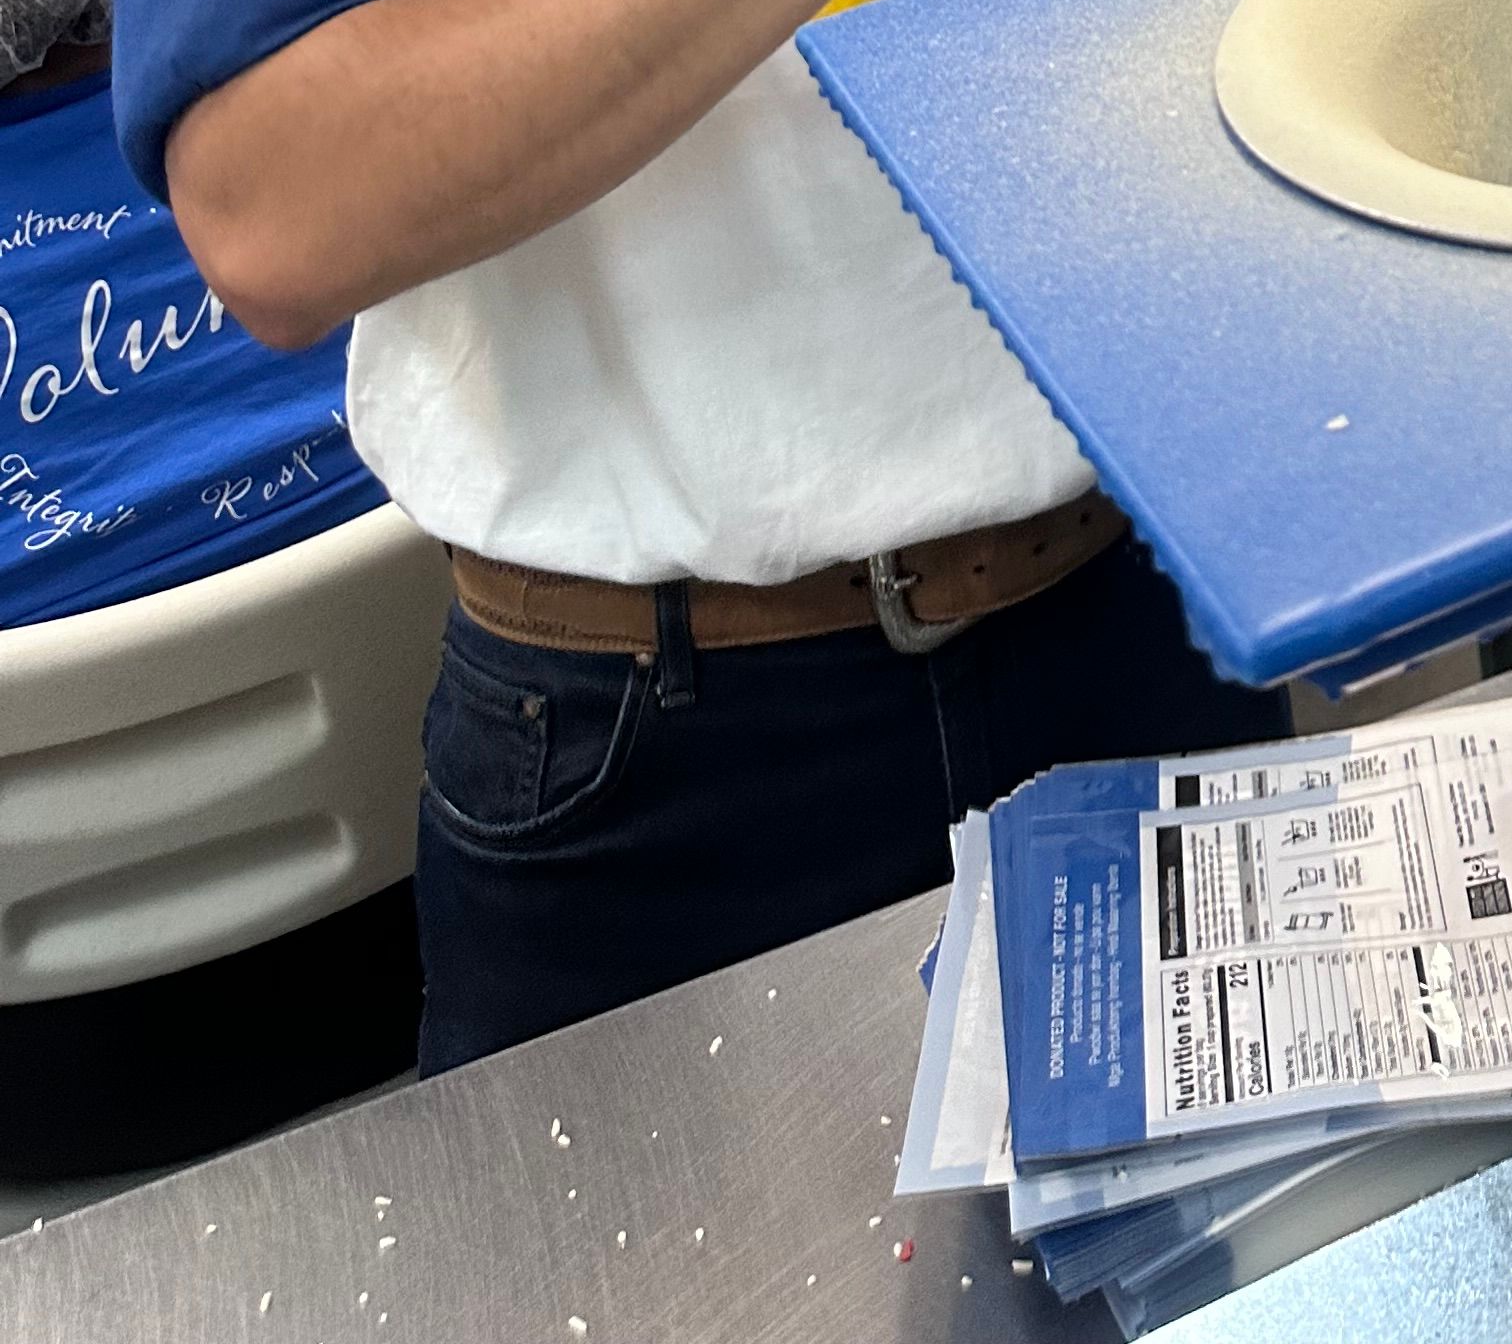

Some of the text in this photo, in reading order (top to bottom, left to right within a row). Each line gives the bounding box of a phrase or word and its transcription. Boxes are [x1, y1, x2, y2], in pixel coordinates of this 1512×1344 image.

[0, 204, 132, 258] itment
[0, 453, 144, 551] Integrit
[1053, 875, 1069, 904] SALE
[1052, 932, 1067, 956] NOT
[1053, 905, 1068, 931] FOR
[1051, 963, 1066, 1016] PRODUCT
[1171, 969, 1191, 1019] Facts
[1050, 1016, 1065, 1080] DONATED
[1227, 961, 1265, 1097] Calories 212
[1172, 1023, 1196, 1111] Nutrition
